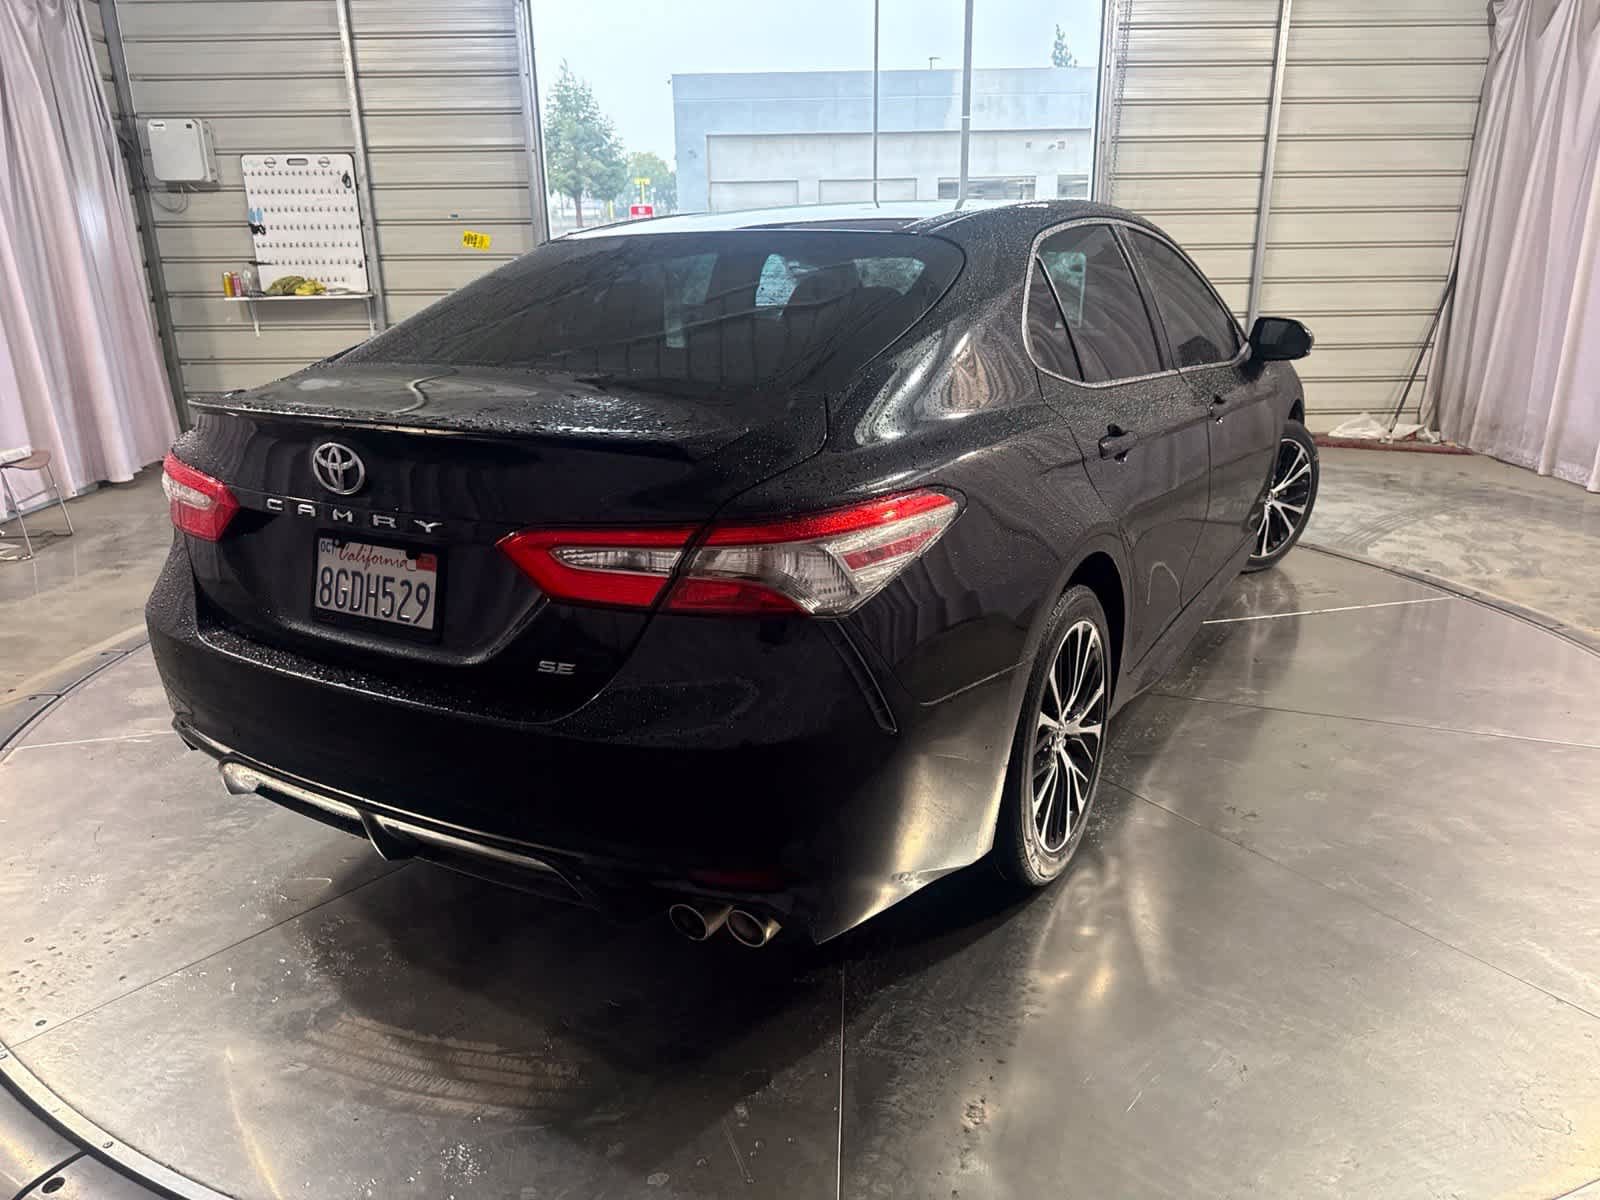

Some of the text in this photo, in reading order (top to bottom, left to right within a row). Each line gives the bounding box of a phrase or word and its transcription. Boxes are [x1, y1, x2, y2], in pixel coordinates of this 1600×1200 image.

[266, 497, 443, 533] CAMRY
[337, 543, 411, 571] California
[318, 565, 431, 625] 8GDH529
[537, 660, 576, 675] SE
